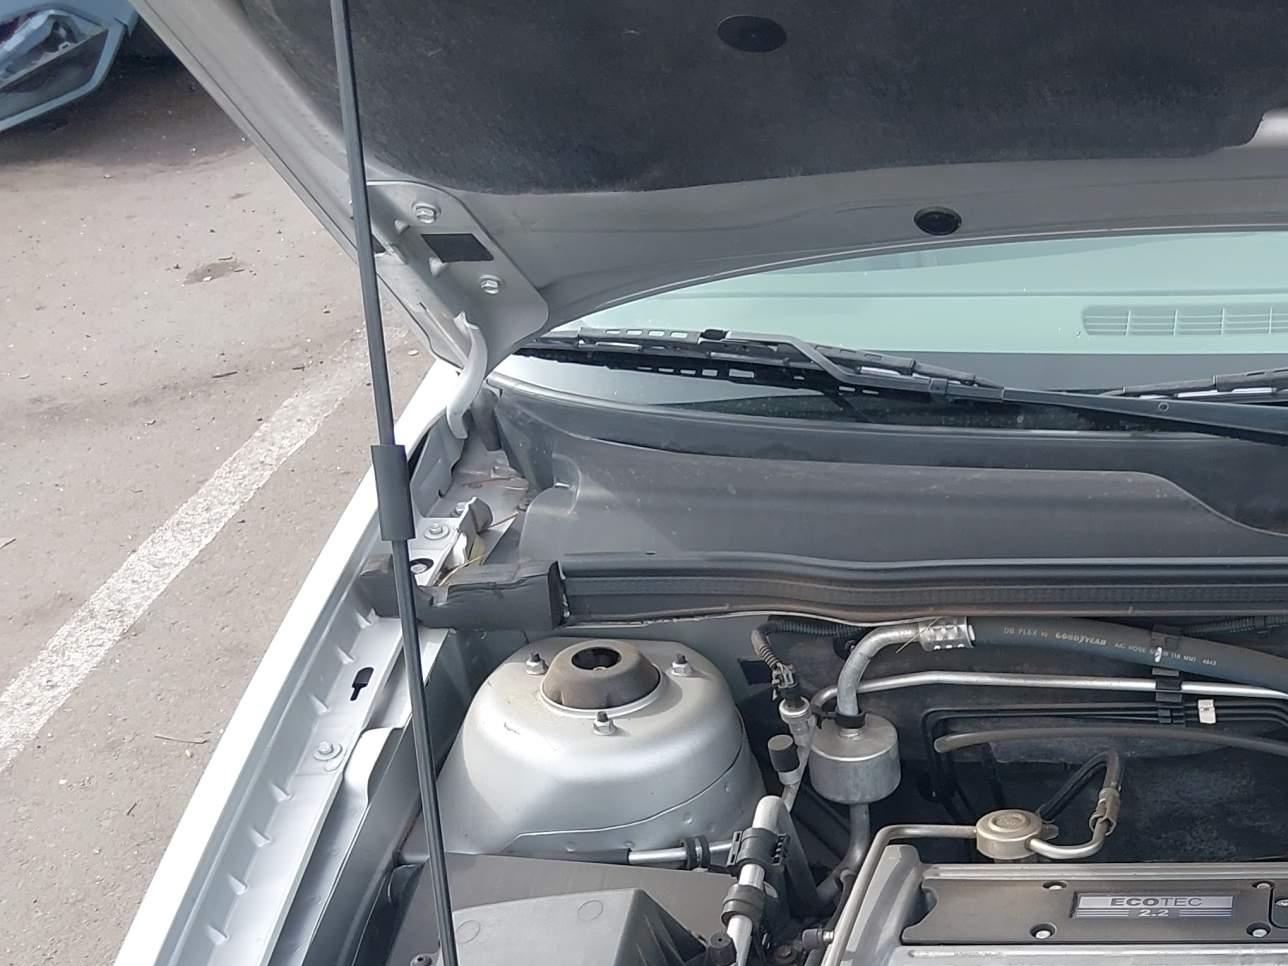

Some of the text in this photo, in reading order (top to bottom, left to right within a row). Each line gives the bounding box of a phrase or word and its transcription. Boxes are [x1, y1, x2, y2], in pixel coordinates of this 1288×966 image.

[1055, 632, 1107, 646] GOODYEAR
[1111, 897, 1202, 907] ECOTEC
[1138, 909, 1169, 918] 2.2
